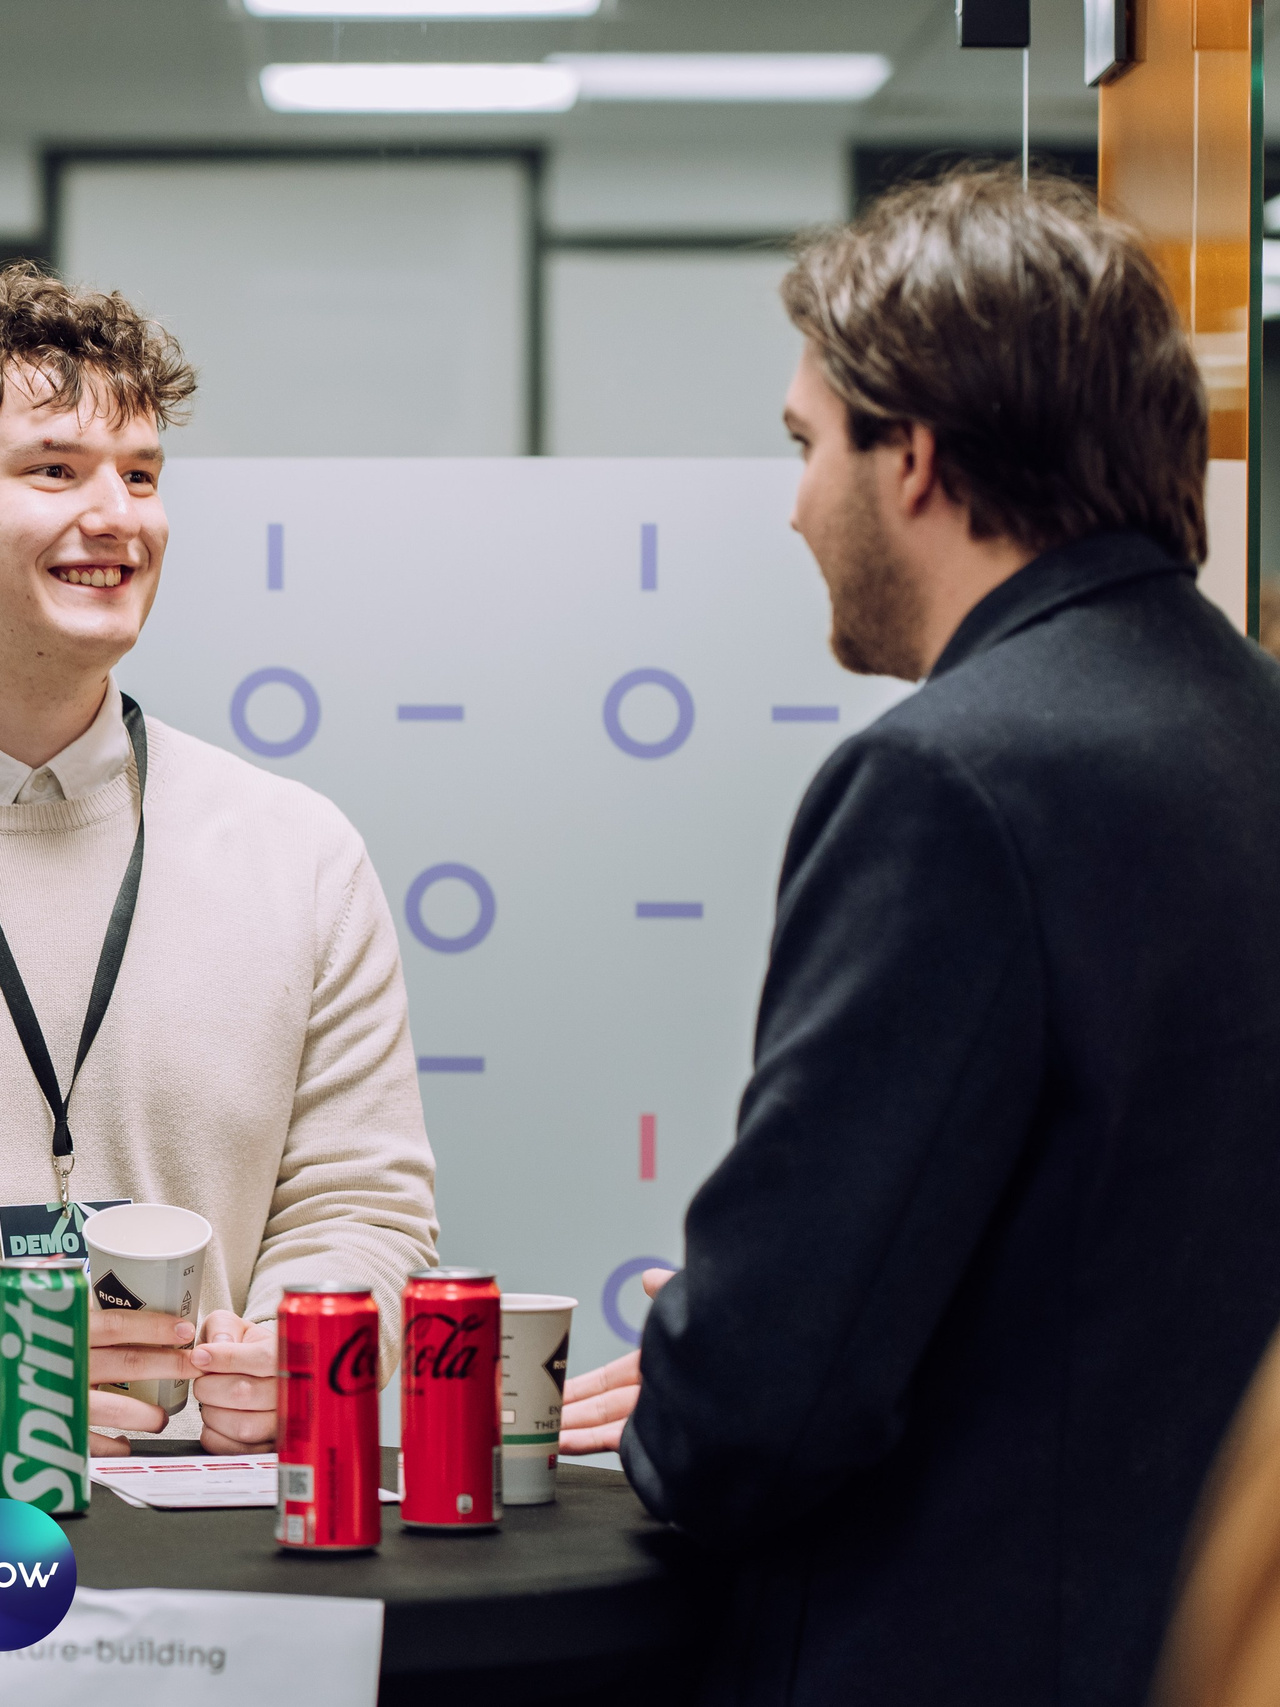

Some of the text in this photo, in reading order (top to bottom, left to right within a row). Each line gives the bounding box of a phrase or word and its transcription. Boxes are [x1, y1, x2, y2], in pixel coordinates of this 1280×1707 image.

[10, 1232, 80, 1256] DEMO
[99, 1290, 132, 1308] RIOBA
[0, 1269, 87, 1513] Sprite
[535, 1419, 555, 1430] THE
